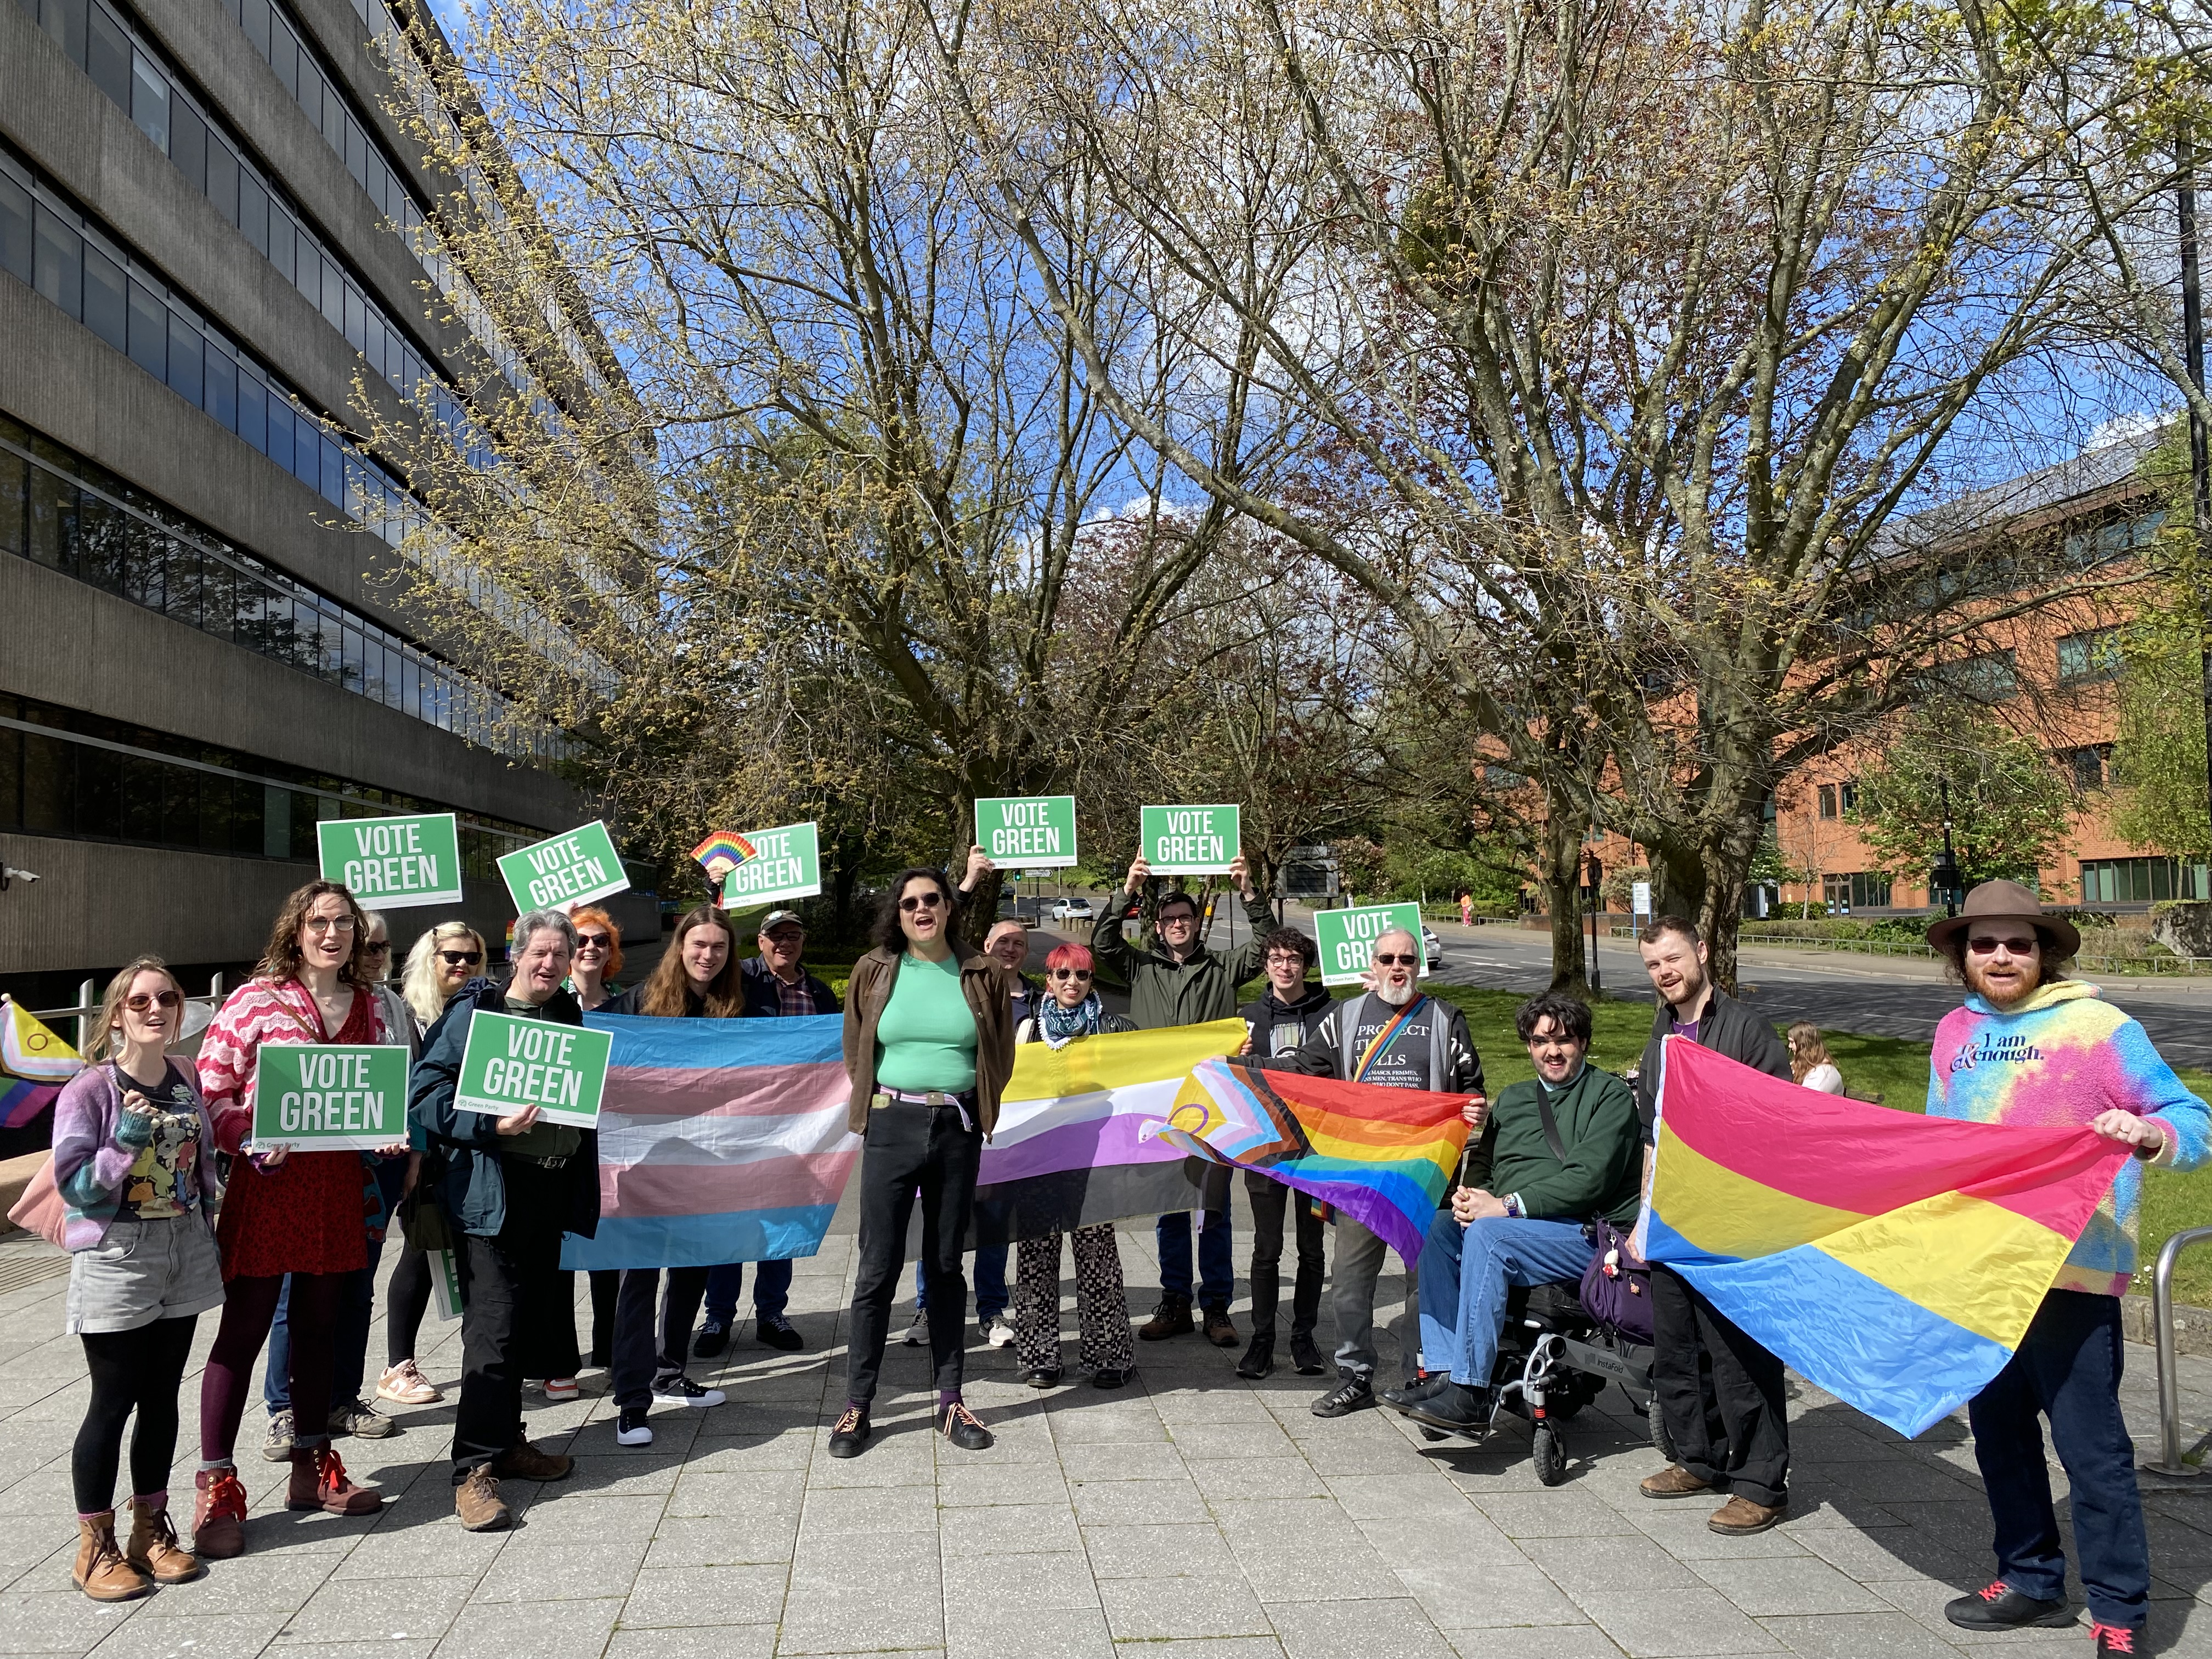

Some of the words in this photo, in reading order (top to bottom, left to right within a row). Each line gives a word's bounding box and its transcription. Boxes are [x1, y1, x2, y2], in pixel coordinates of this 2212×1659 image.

[1001, 802, 1049, 827] VOTE
[1166, 811, 1214, 834] VOTE
[354, 823, 421, 856] VOTE
[992, 827, 1060, 855] GREEN
[1157, 836, 1223, 862] GREEN
[527, 836, 586, 876] VOTE
[344, 854, 438, 894] GREEN
[528, 856, 607, 907] GREEN
[736, 856, 803, 893] GREEN
[1342, 911, 1392, 940] VOTE
[1336, 939, 1375, 970] GRE
[507, 1024, 576, 1066] VOTE
[1357, 1024, 1429, 1036] PROCT
[1984, 1033, 1990, 1048] I
[1997, 1035, 2026, 1048] am
[298, 1054, 371, 1089] VOTE
[483, 1057, 583, 1107] GREEN
[280, 1091, 383, 1132] GREEN
[1597, 1358, 1623, 1373] InstaFold
